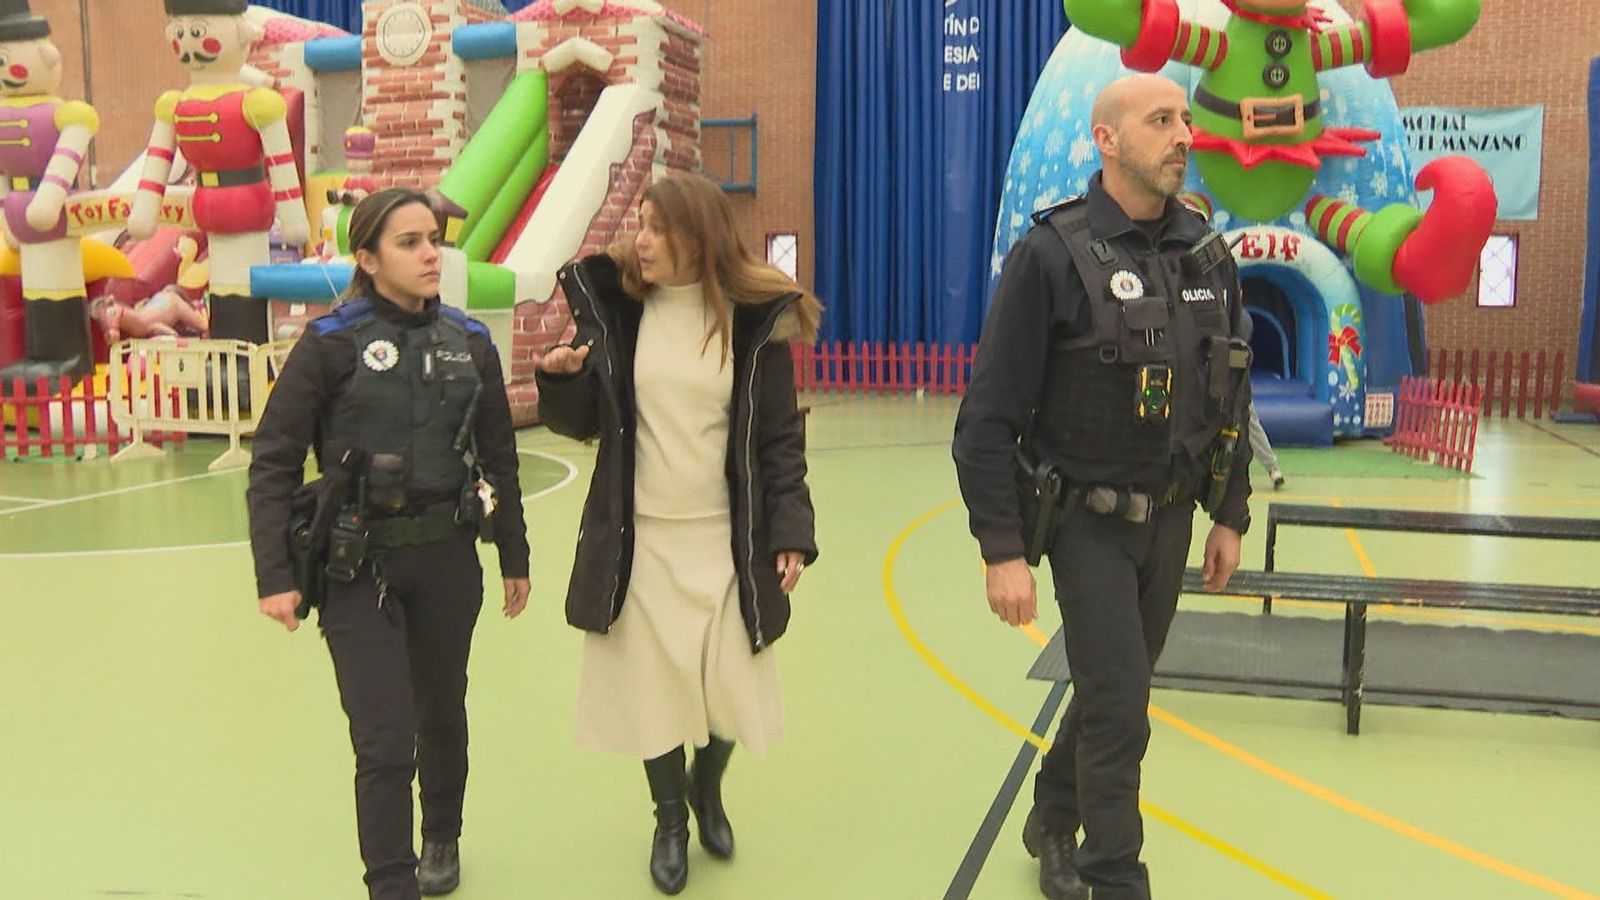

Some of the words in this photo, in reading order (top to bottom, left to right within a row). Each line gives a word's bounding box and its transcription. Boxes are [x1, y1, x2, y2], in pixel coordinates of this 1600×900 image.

[943, 73, 952, 91] E
[1440, 133, 1528, 151] MANZANO
[108, 198, 184, 222] Fary
[1181, 288, 1216, 302] OLICIA
